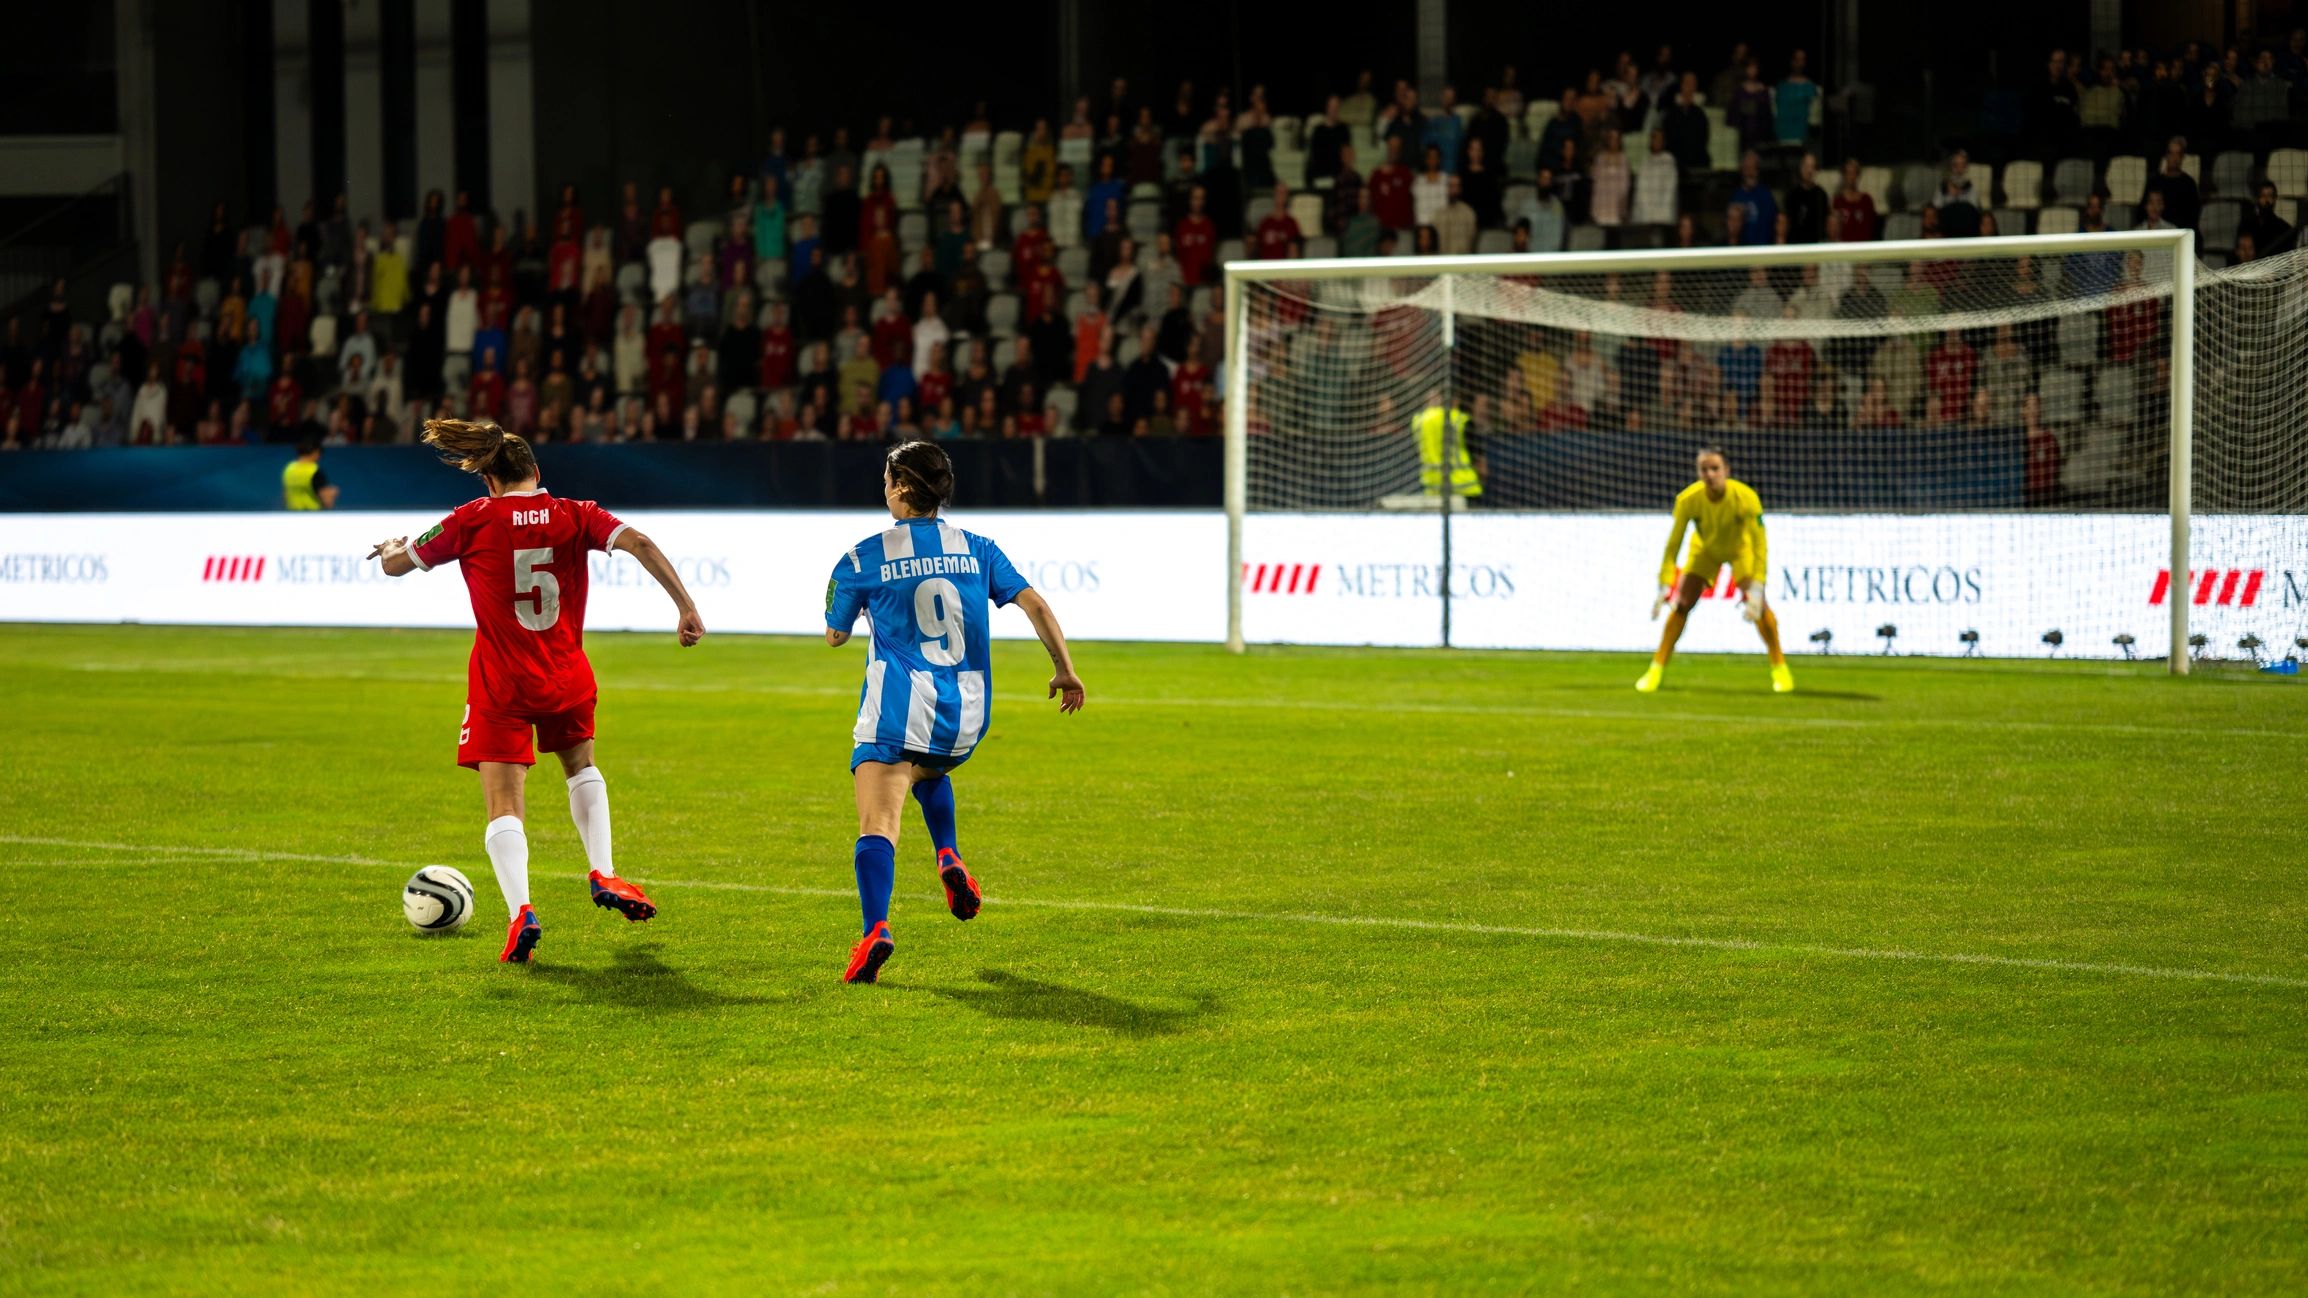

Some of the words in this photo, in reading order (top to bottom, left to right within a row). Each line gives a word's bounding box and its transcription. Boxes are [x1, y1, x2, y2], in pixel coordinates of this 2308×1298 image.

[512, 508, 550, 526] RICH
[880, 556, 980, 583] BLENDEMAN
[1782, 566, 1983, 604] METRICOS
[513, 547, 560, 632] 5
[914, 578, 966, 667] 9
